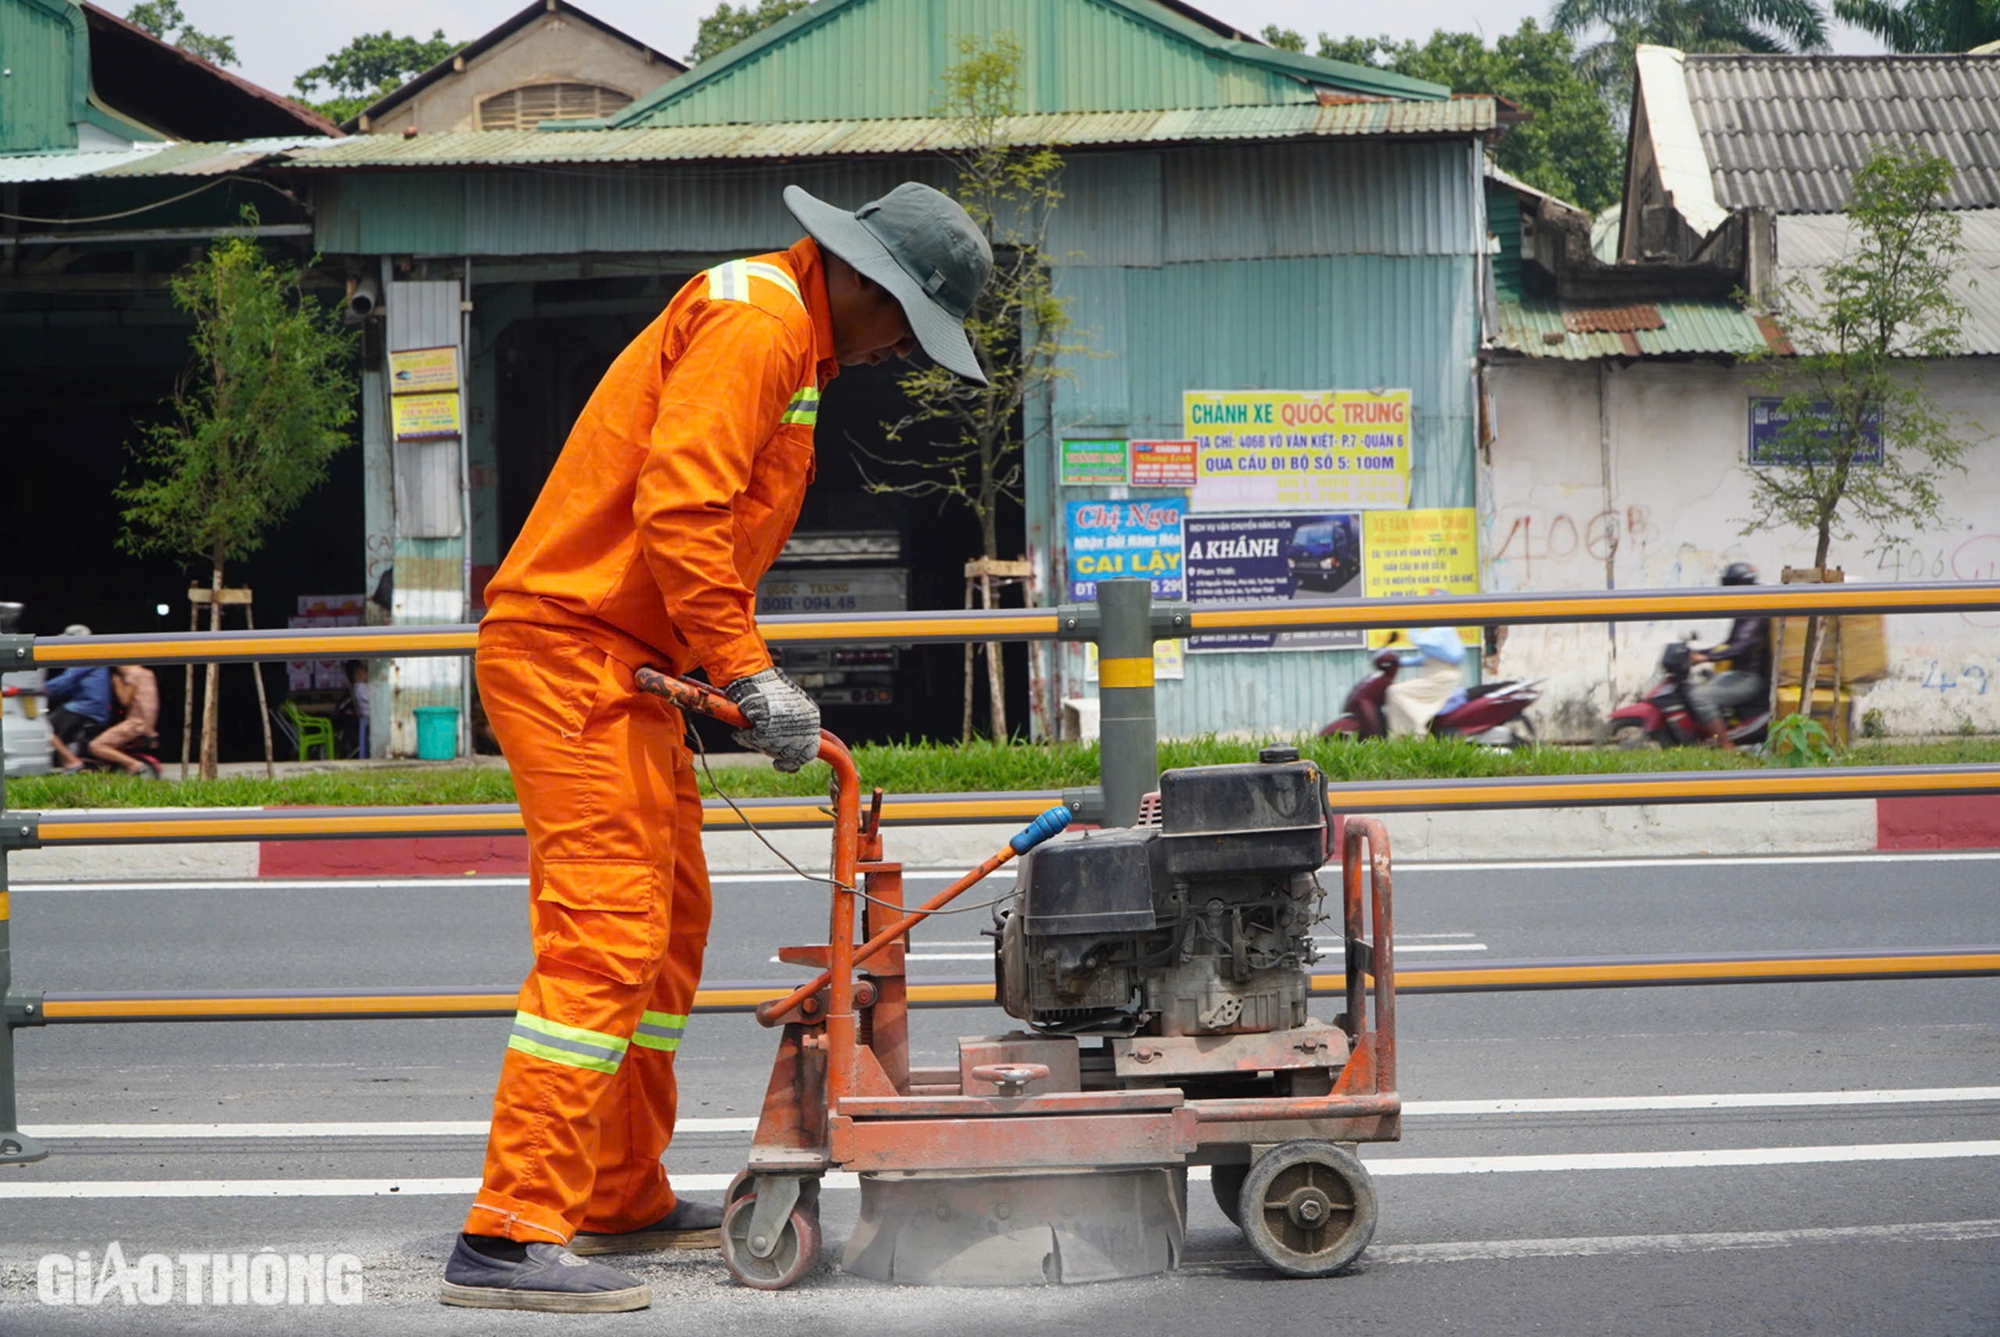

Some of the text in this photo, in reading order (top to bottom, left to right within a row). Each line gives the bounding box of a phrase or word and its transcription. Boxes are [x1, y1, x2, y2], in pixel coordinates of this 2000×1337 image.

[1191, 399, 1405, 426] CHÀNH XE QUỐC TRUNG
[1397, 434, 1404, 448] 6
[1205, 456, 1233, 472] QUA
[1271, 456, 1286, 470] ĐI
[1290, 453, 1309, 473] BỘ
[1313, 453, 1333, 470] SỐ
[1338, 456, 1351, 470] 5:
[1357, 456, 1395, 470] 100M
[1077, 503, 1179, 532] Chị Nga
[1188, 535, 1279, 560] A KHÁNH
[1076, 550, 1182, 575] CAI LẬY
[1877, 548, 1945, 581] 406
